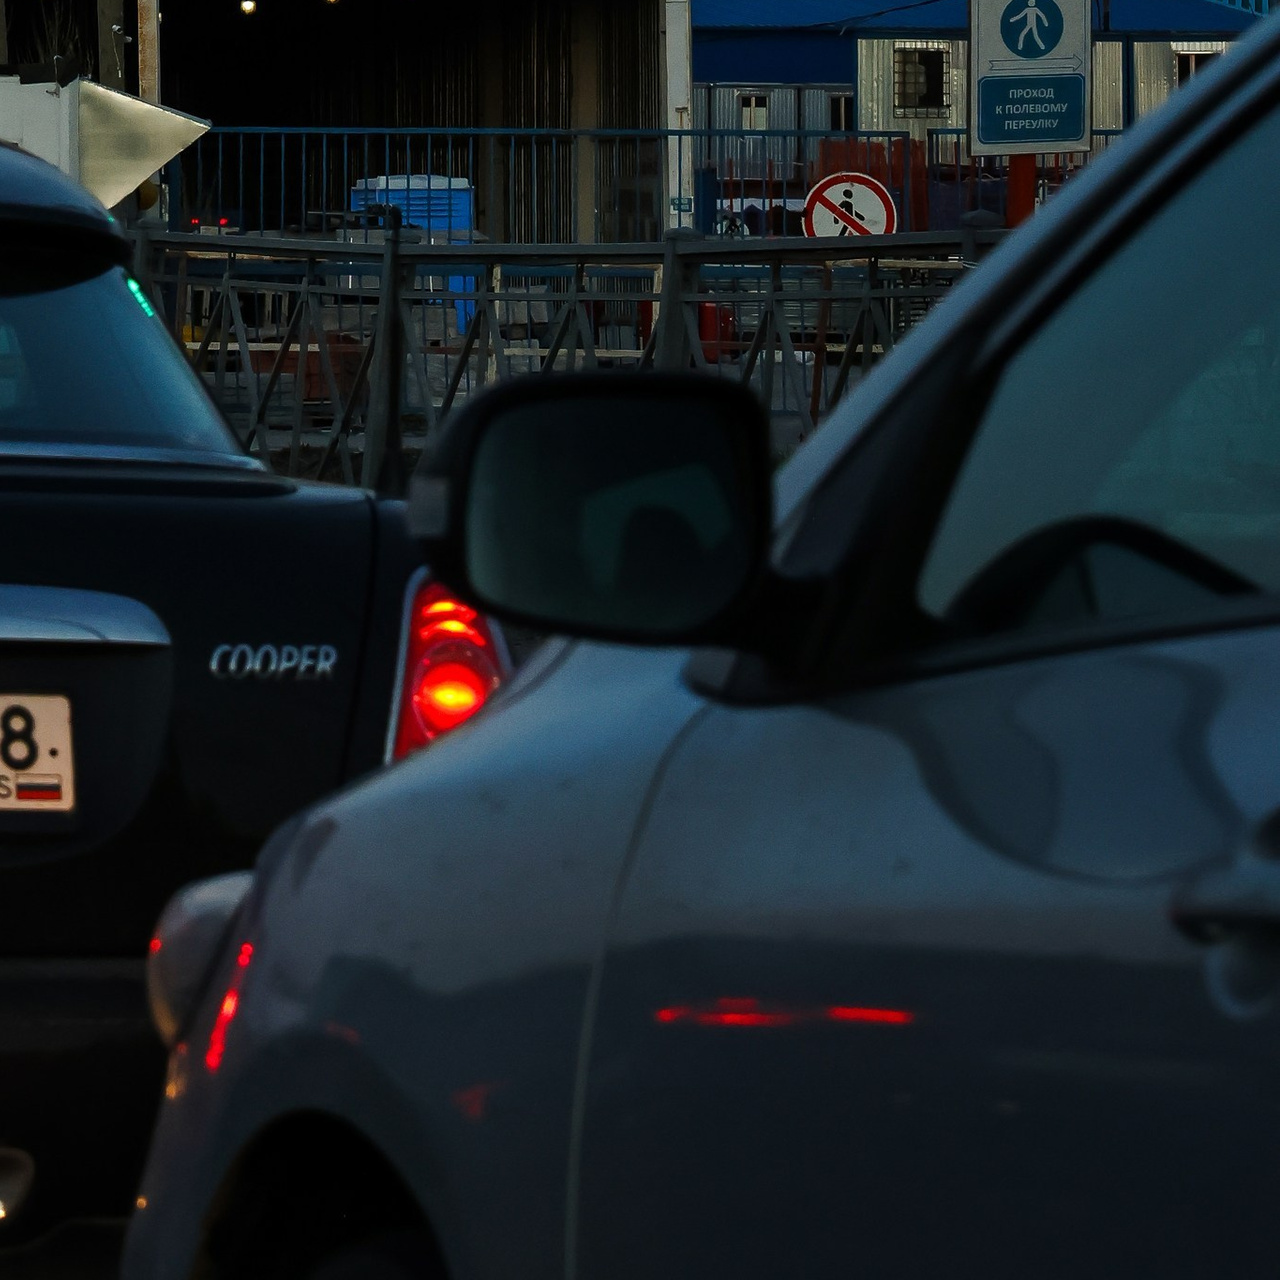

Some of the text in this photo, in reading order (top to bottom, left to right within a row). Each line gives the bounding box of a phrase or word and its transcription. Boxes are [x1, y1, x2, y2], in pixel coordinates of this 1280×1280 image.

[1009, 88, 1055, 99] ПРОХОД
[995, 103, 1069, 115] К ПОЛЕВОМУ
[1004, 118, 1060, 130] ПЕРЕУЛКУ
[209, 643, 339, 680] COOPER
